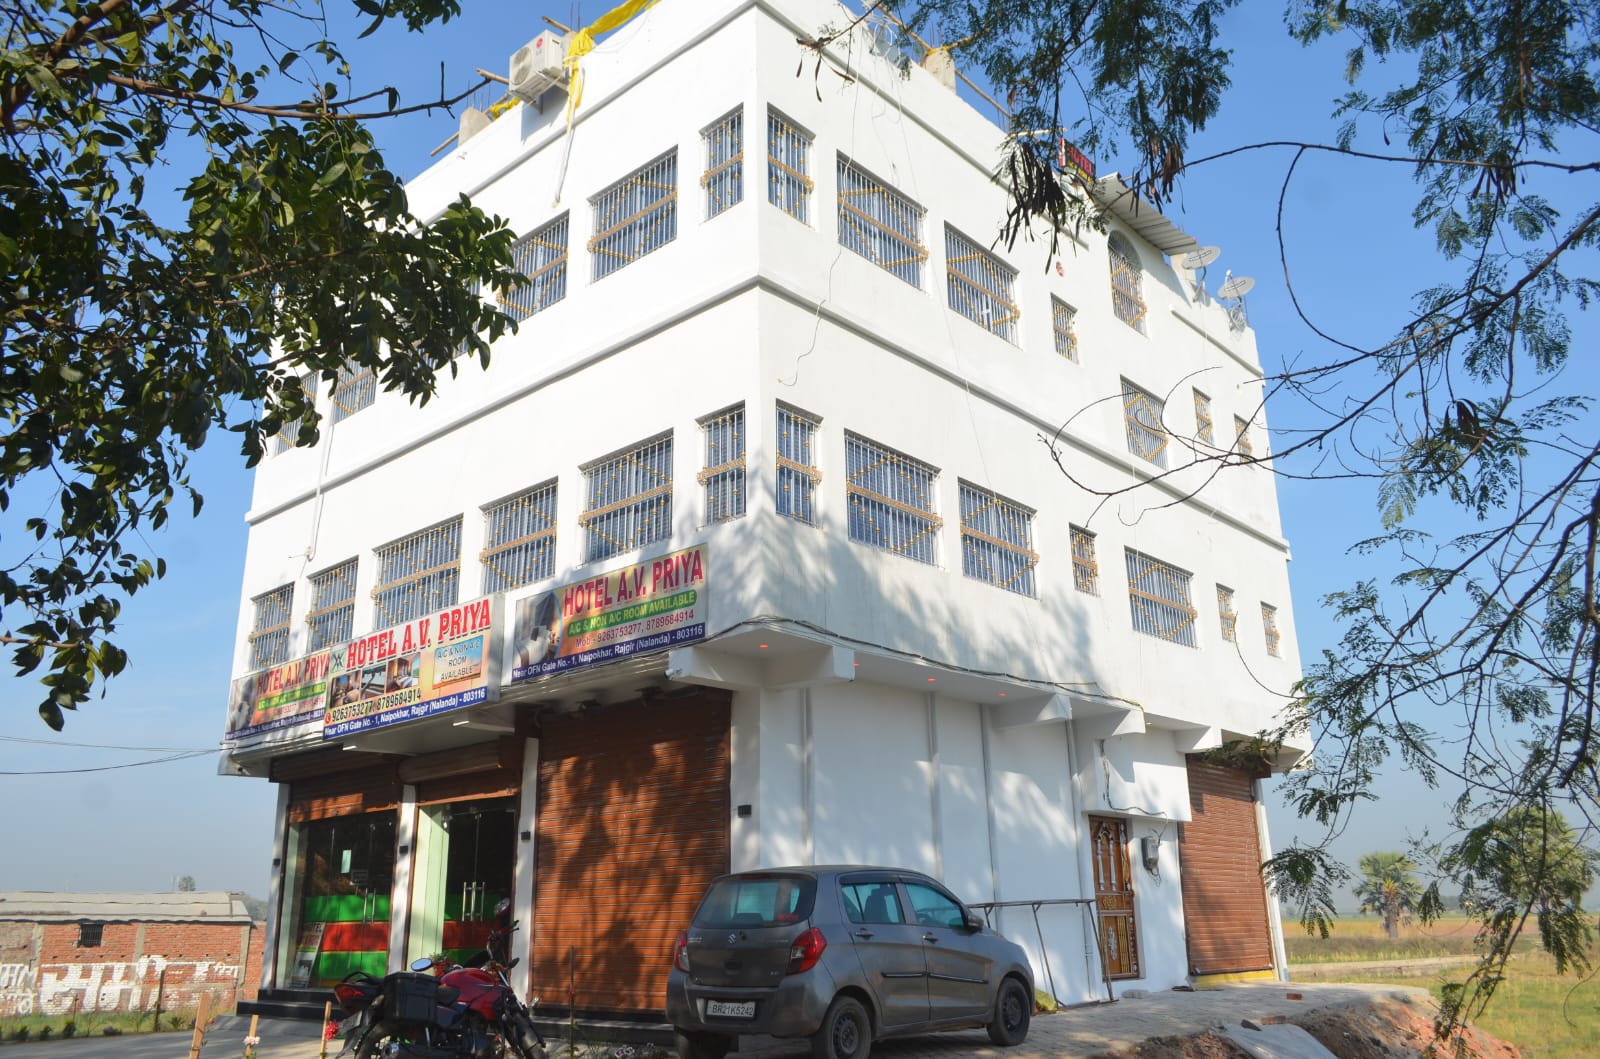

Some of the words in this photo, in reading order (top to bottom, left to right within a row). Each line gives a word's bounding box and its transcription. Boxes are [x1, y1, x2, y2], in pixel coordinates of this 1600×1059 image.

[564, 577, 612, 617] HOTEL
[617, 566, 646, 602] A.V.
[652, 550, 703, 593] PRIYA
[590, 617, 607, 629] NON
[609, 612, 621, 623] A/C
[624, 606, 647, 619] ROOM
[649, 591, 695, 612] AVAILABLE
[346, 630, 397, 669] HOTEL
[402, 619, 431, 652] A.V.
[438, 599, 491, 641] PRIYA
[513, 668, 526, 678] Near
[542, 662, 556, 672] Gate
[614, 642, 634, 654] Rajgir
[636, 633, 671, 651] (Nalanda)
[677, 625, 703, 640] 803116
[441, 665, 472, 680] AVAILABLE
[449, 656, 467, 667] ROOM
[257, 668, 284, 695] HOTEL
[324, 727, 336, 737] Near
[411, 704, 428, 716] Rajgir
[430, 695, 458, 713] (Nalanda)
[463, 688, 485, 703] 803116
[712, 1004, 754, 1016] BR21K5242
